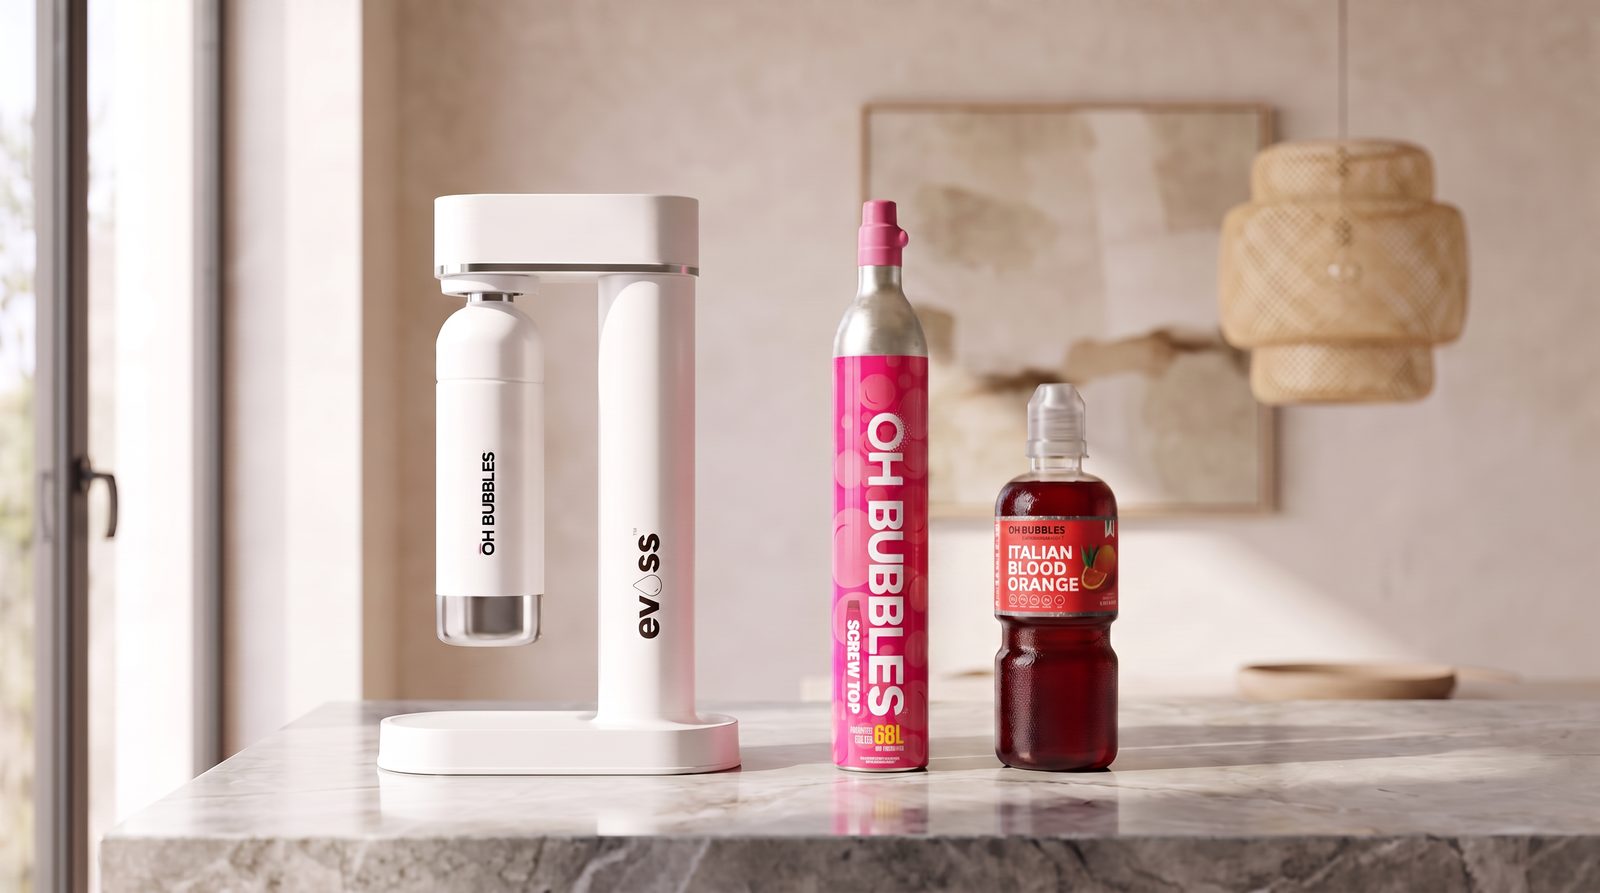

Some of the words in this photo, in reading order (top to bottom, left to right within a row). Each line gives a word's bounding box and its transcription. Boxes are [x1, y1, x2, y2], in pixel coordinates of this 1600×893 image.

[867, 412, 905, 486] OH
[481, 451, 496, 526] BUBBLES
[481, 530, 496, 556] OH
[1008, 525, 1021, 535] OH
[1021, 525, 1066, 535] BUBBLES
[1008, 544, 1073, 560] ITALIAN
[1007, 561, 1067, 576] BLOOD
[1007, 577, 1080, 592] ORANGE
[867, 500, 905, 717] BUBBLES
[846, 619, 861, 678] SCREW
[846, 679, 861, 715] TOP
[873, 724, 905, 746] 68L
